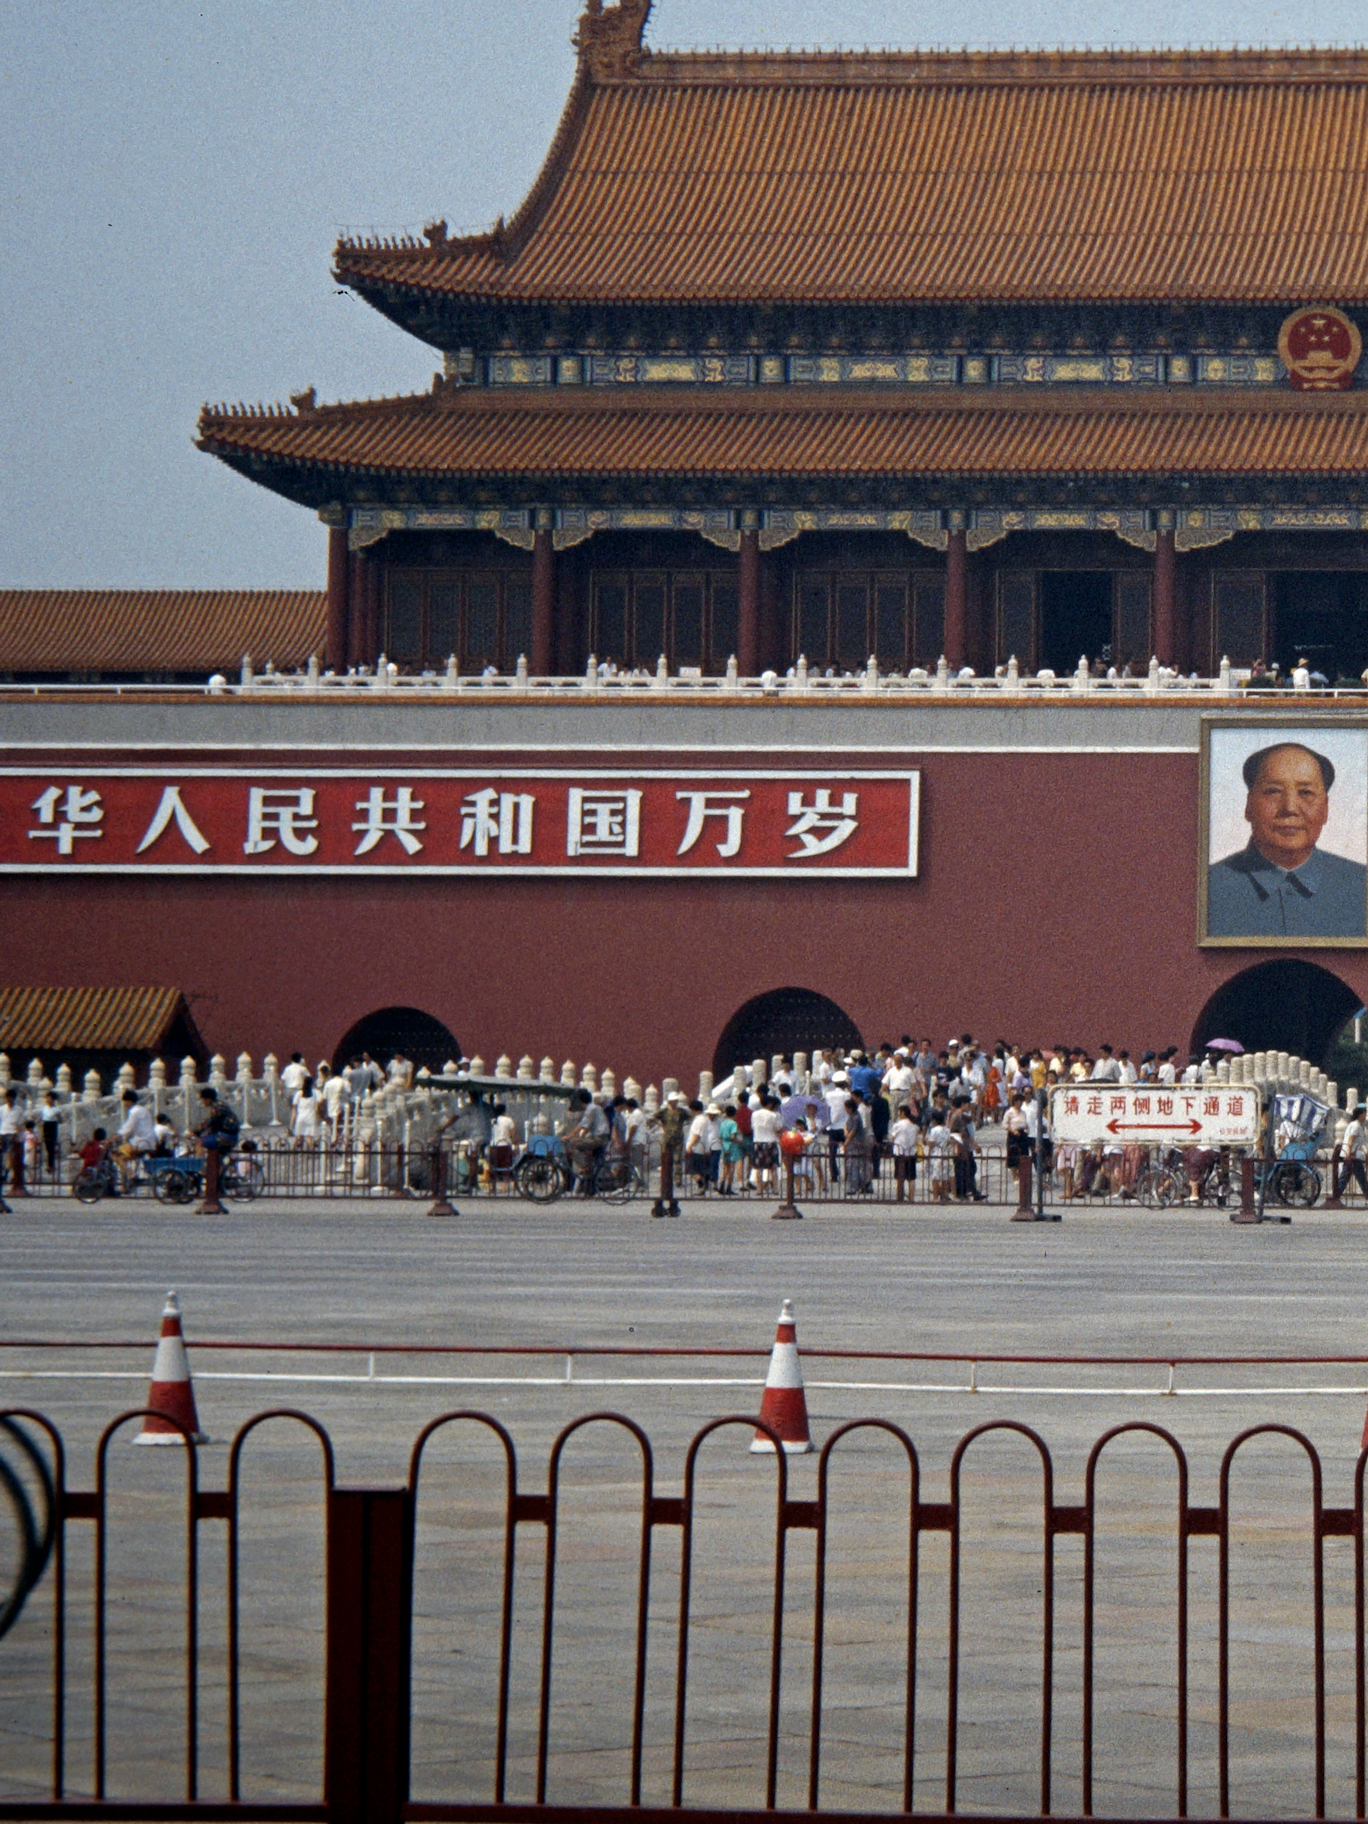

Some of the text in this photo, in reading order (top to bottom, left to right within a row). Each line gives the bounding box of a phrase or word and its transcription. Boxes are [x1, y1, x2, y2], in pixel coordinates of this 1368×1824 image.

[27, 785, 859, 858] 华人民共和国万岁
[1064, 1095, 1244, 1117] 请走两侧地下通道
